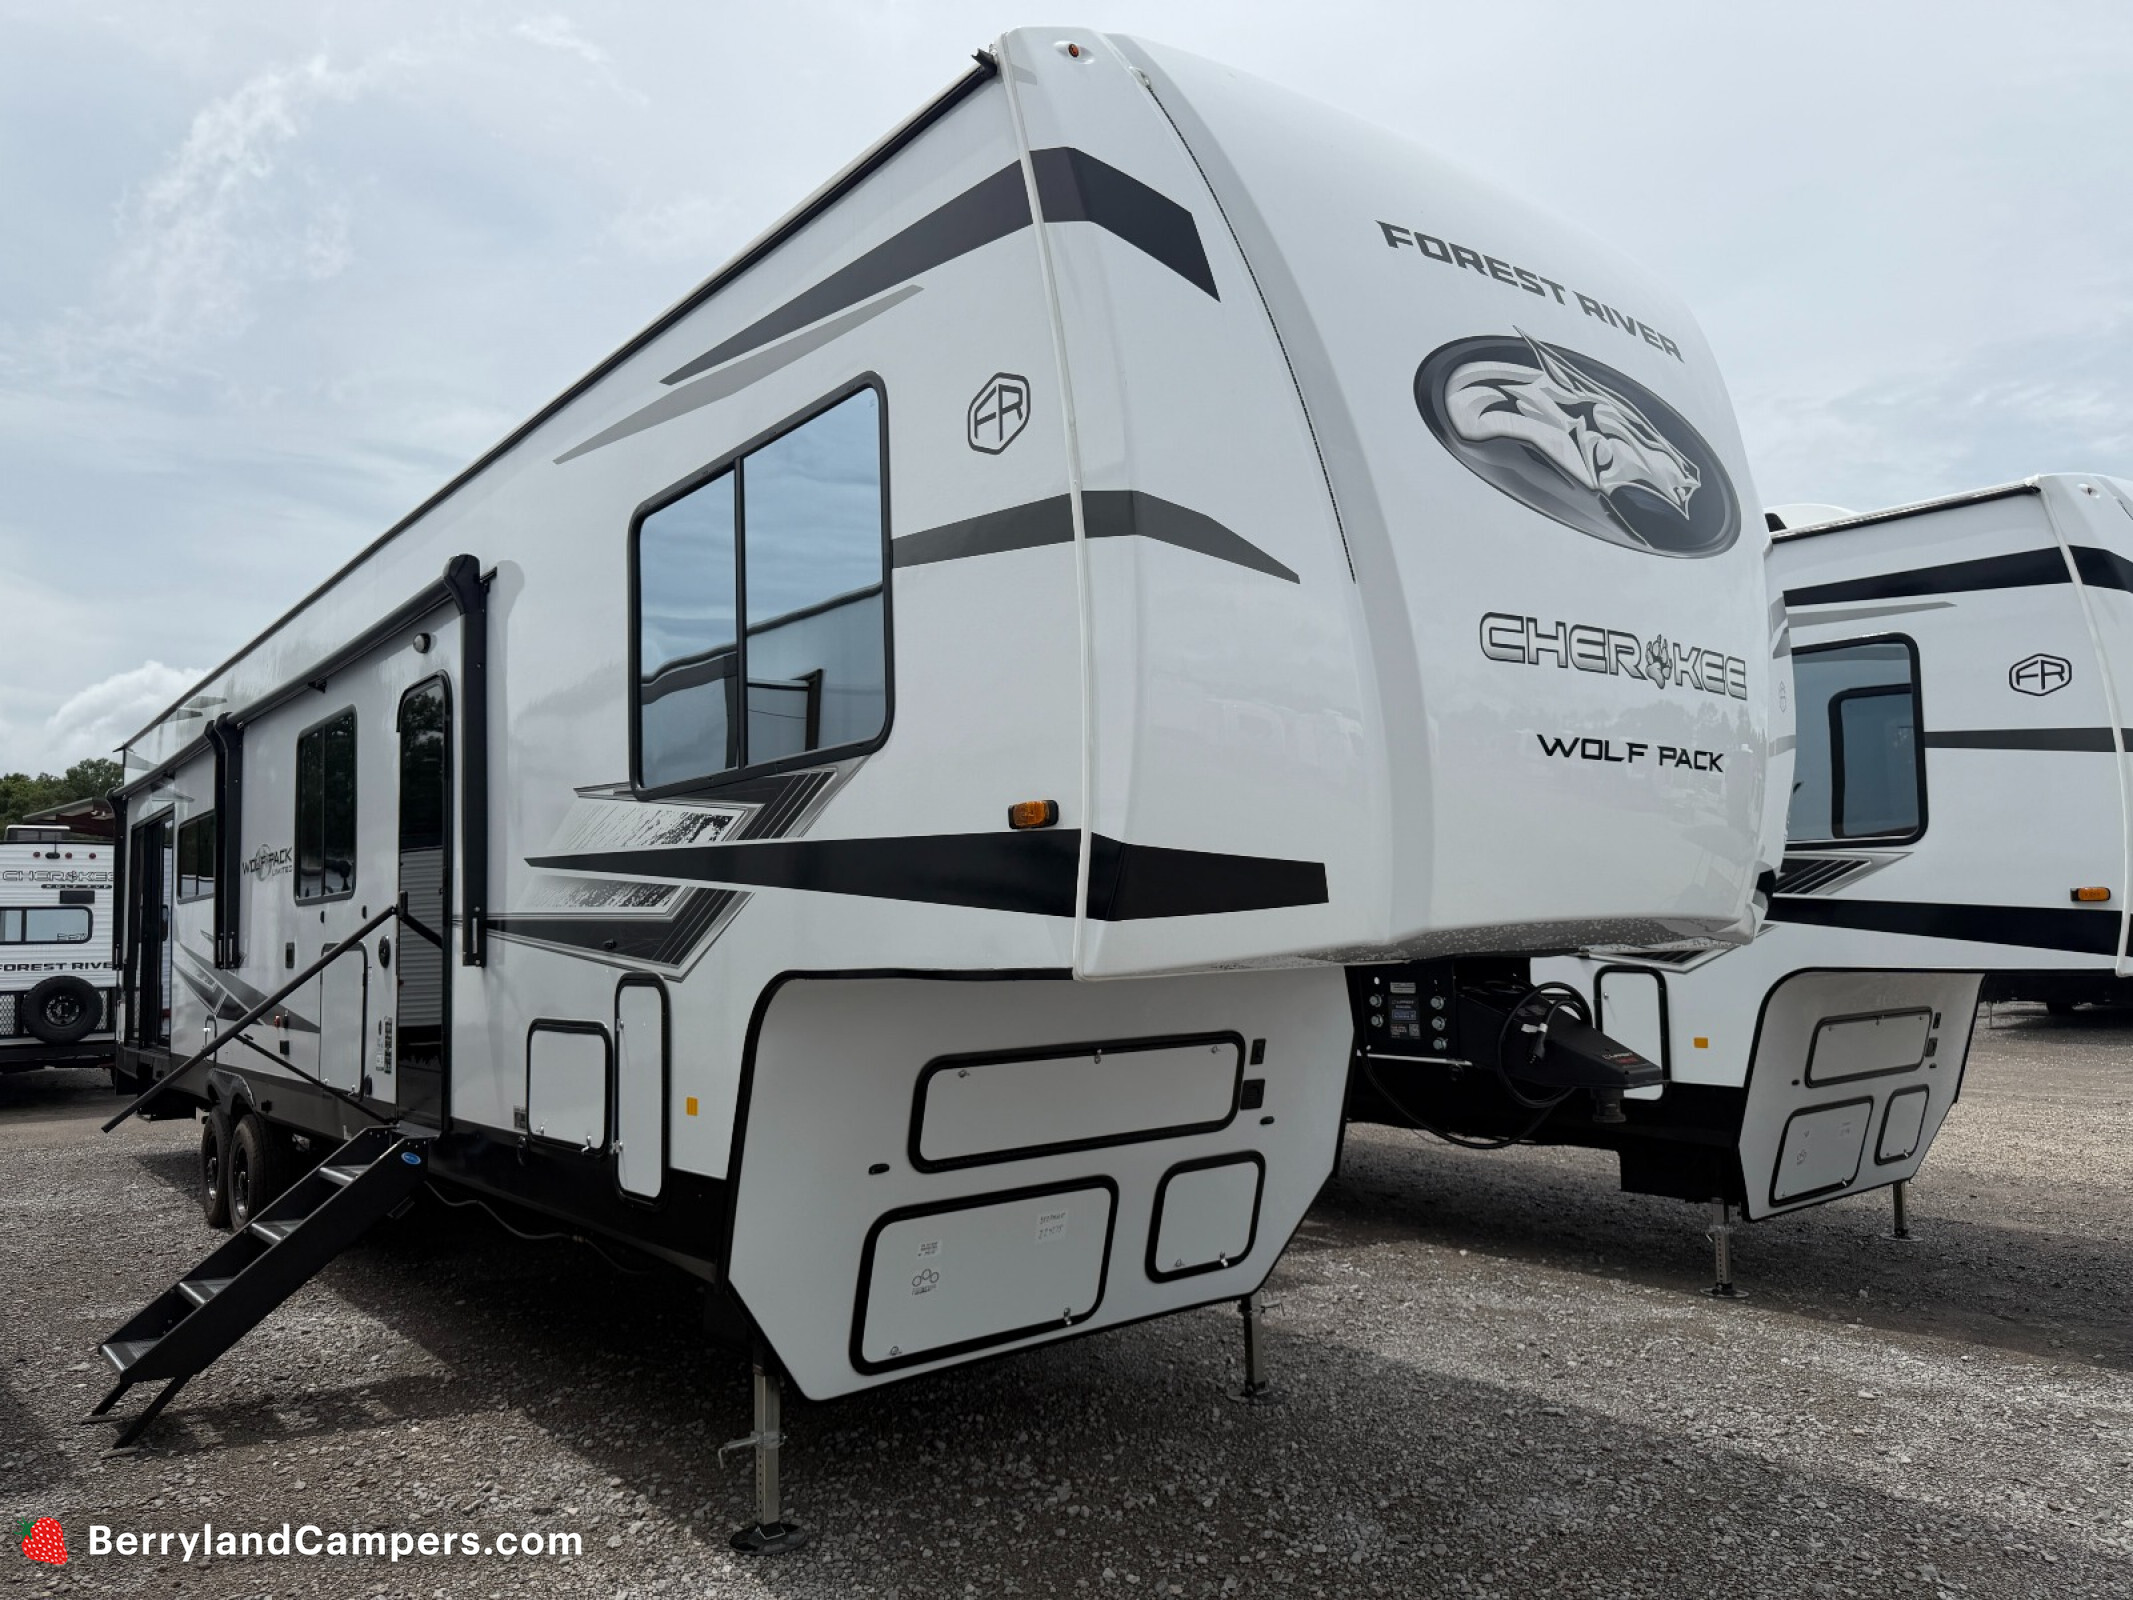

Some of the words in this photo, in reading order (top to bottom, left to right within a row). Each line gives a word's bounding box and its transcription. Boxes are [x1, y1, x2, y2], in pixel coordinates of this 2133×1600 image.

[1374, 219, 1567, 306] FOREST
[1572, 289, 1686, 364] RIVER
[973, 382, 1024, 442] FR
[1479, 611, 1748, 701] CHEROKEE
[2015, 659, 2066, 690] FR
[1537, 733, 1649, 764] WOLF
[1656, 740, 1724, 773] PACK
[0, 962, 67, 972] OREST
[71, 961, 113, 970] RIVE
